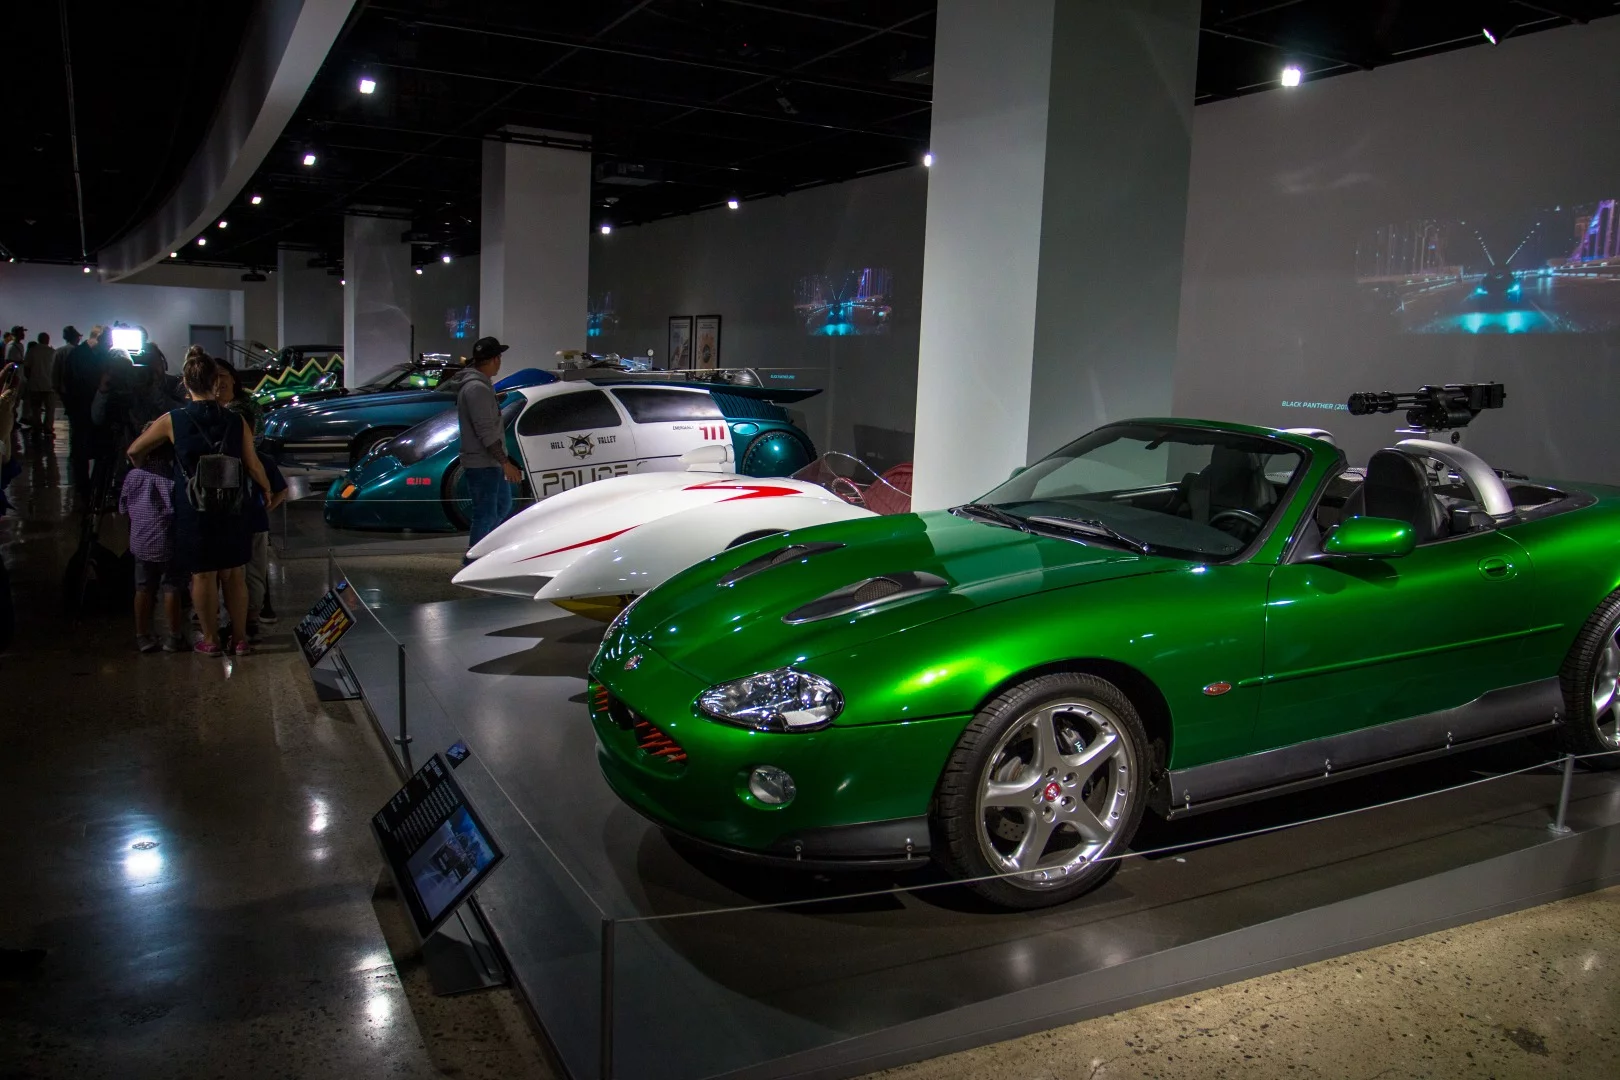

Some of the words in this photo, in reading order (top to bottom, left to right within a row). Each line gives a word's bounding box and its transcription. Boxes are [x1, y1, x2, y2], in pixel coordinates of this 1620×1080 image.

[1281, 400, 1302, 408] BLACK
[1302, 401, 1334, 410] PANTHER
[1334, 403, 1349, 411] (201
[550, 441, 565, 450] HILL
[597, 435, 616, 445] VALLEY
